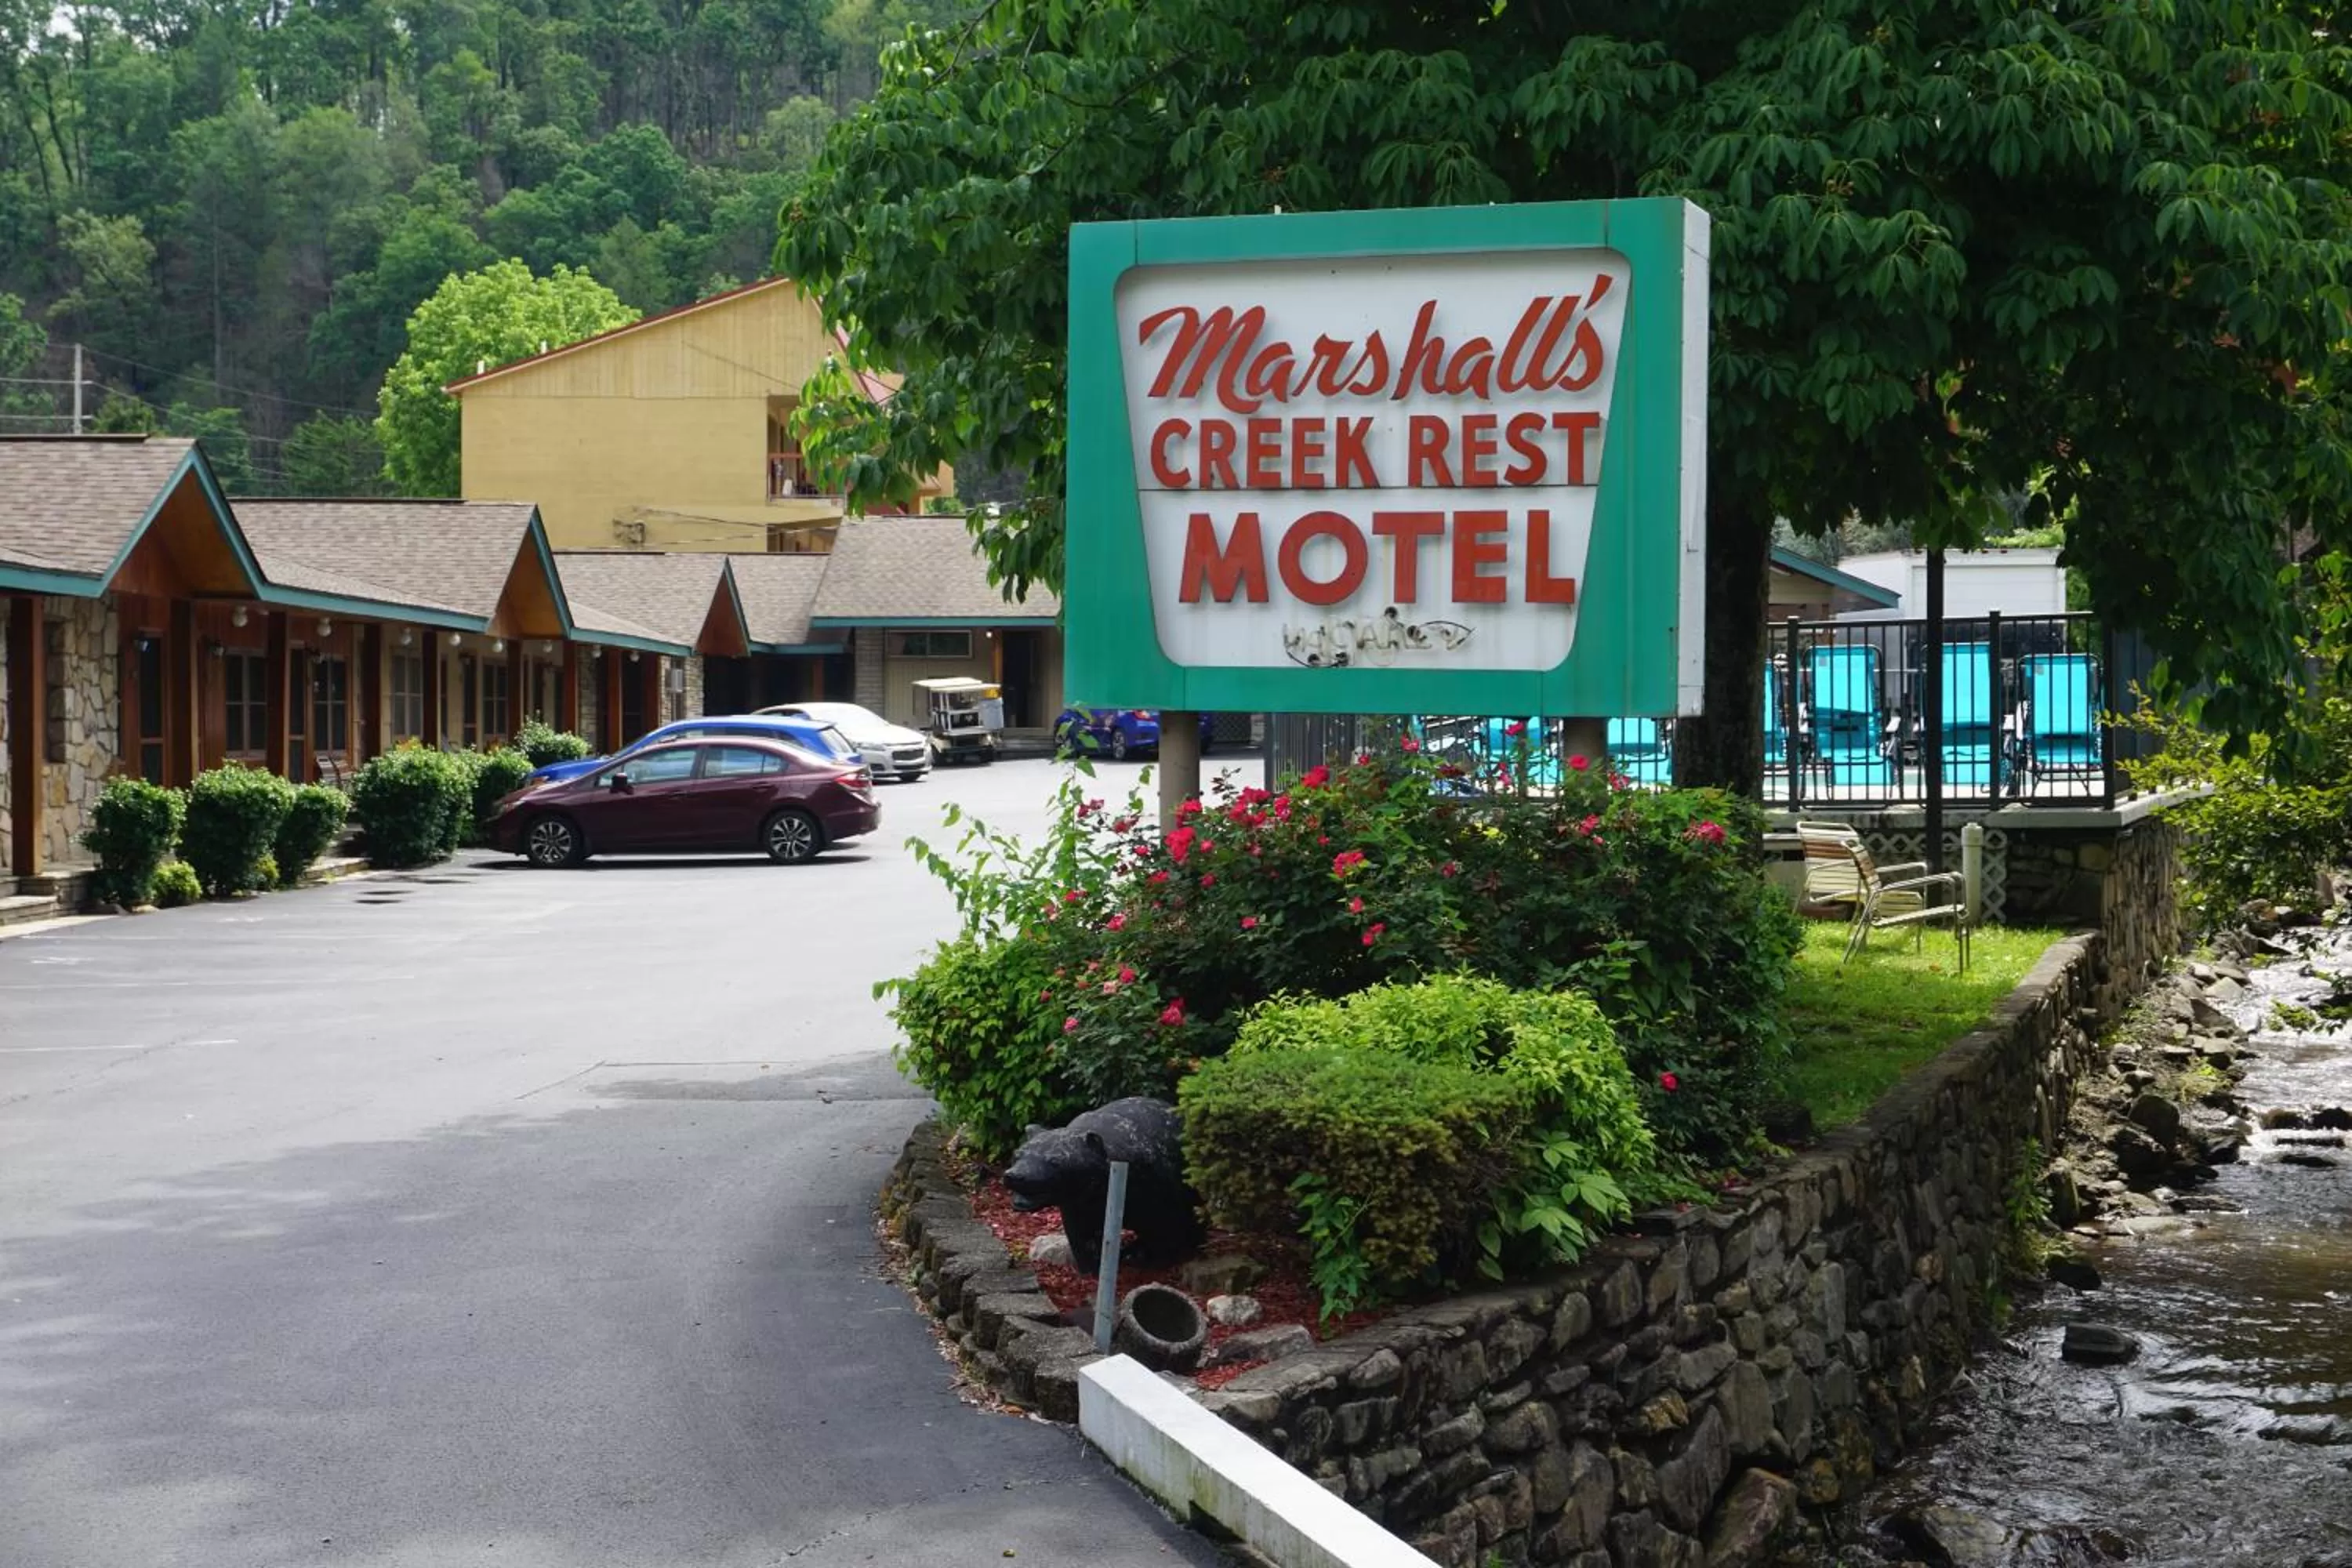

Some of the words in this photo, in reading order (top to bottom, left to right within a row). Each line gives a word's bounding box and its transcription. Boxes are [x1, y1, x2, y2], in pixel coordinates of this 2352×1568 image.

[1139, 274, 1613, 413] Marshall's
[1150, 418, 1380, 488] CREEK
[1408, 412, 1600, 486] REST
[1179, 510, 1576, 605] MOTEL
